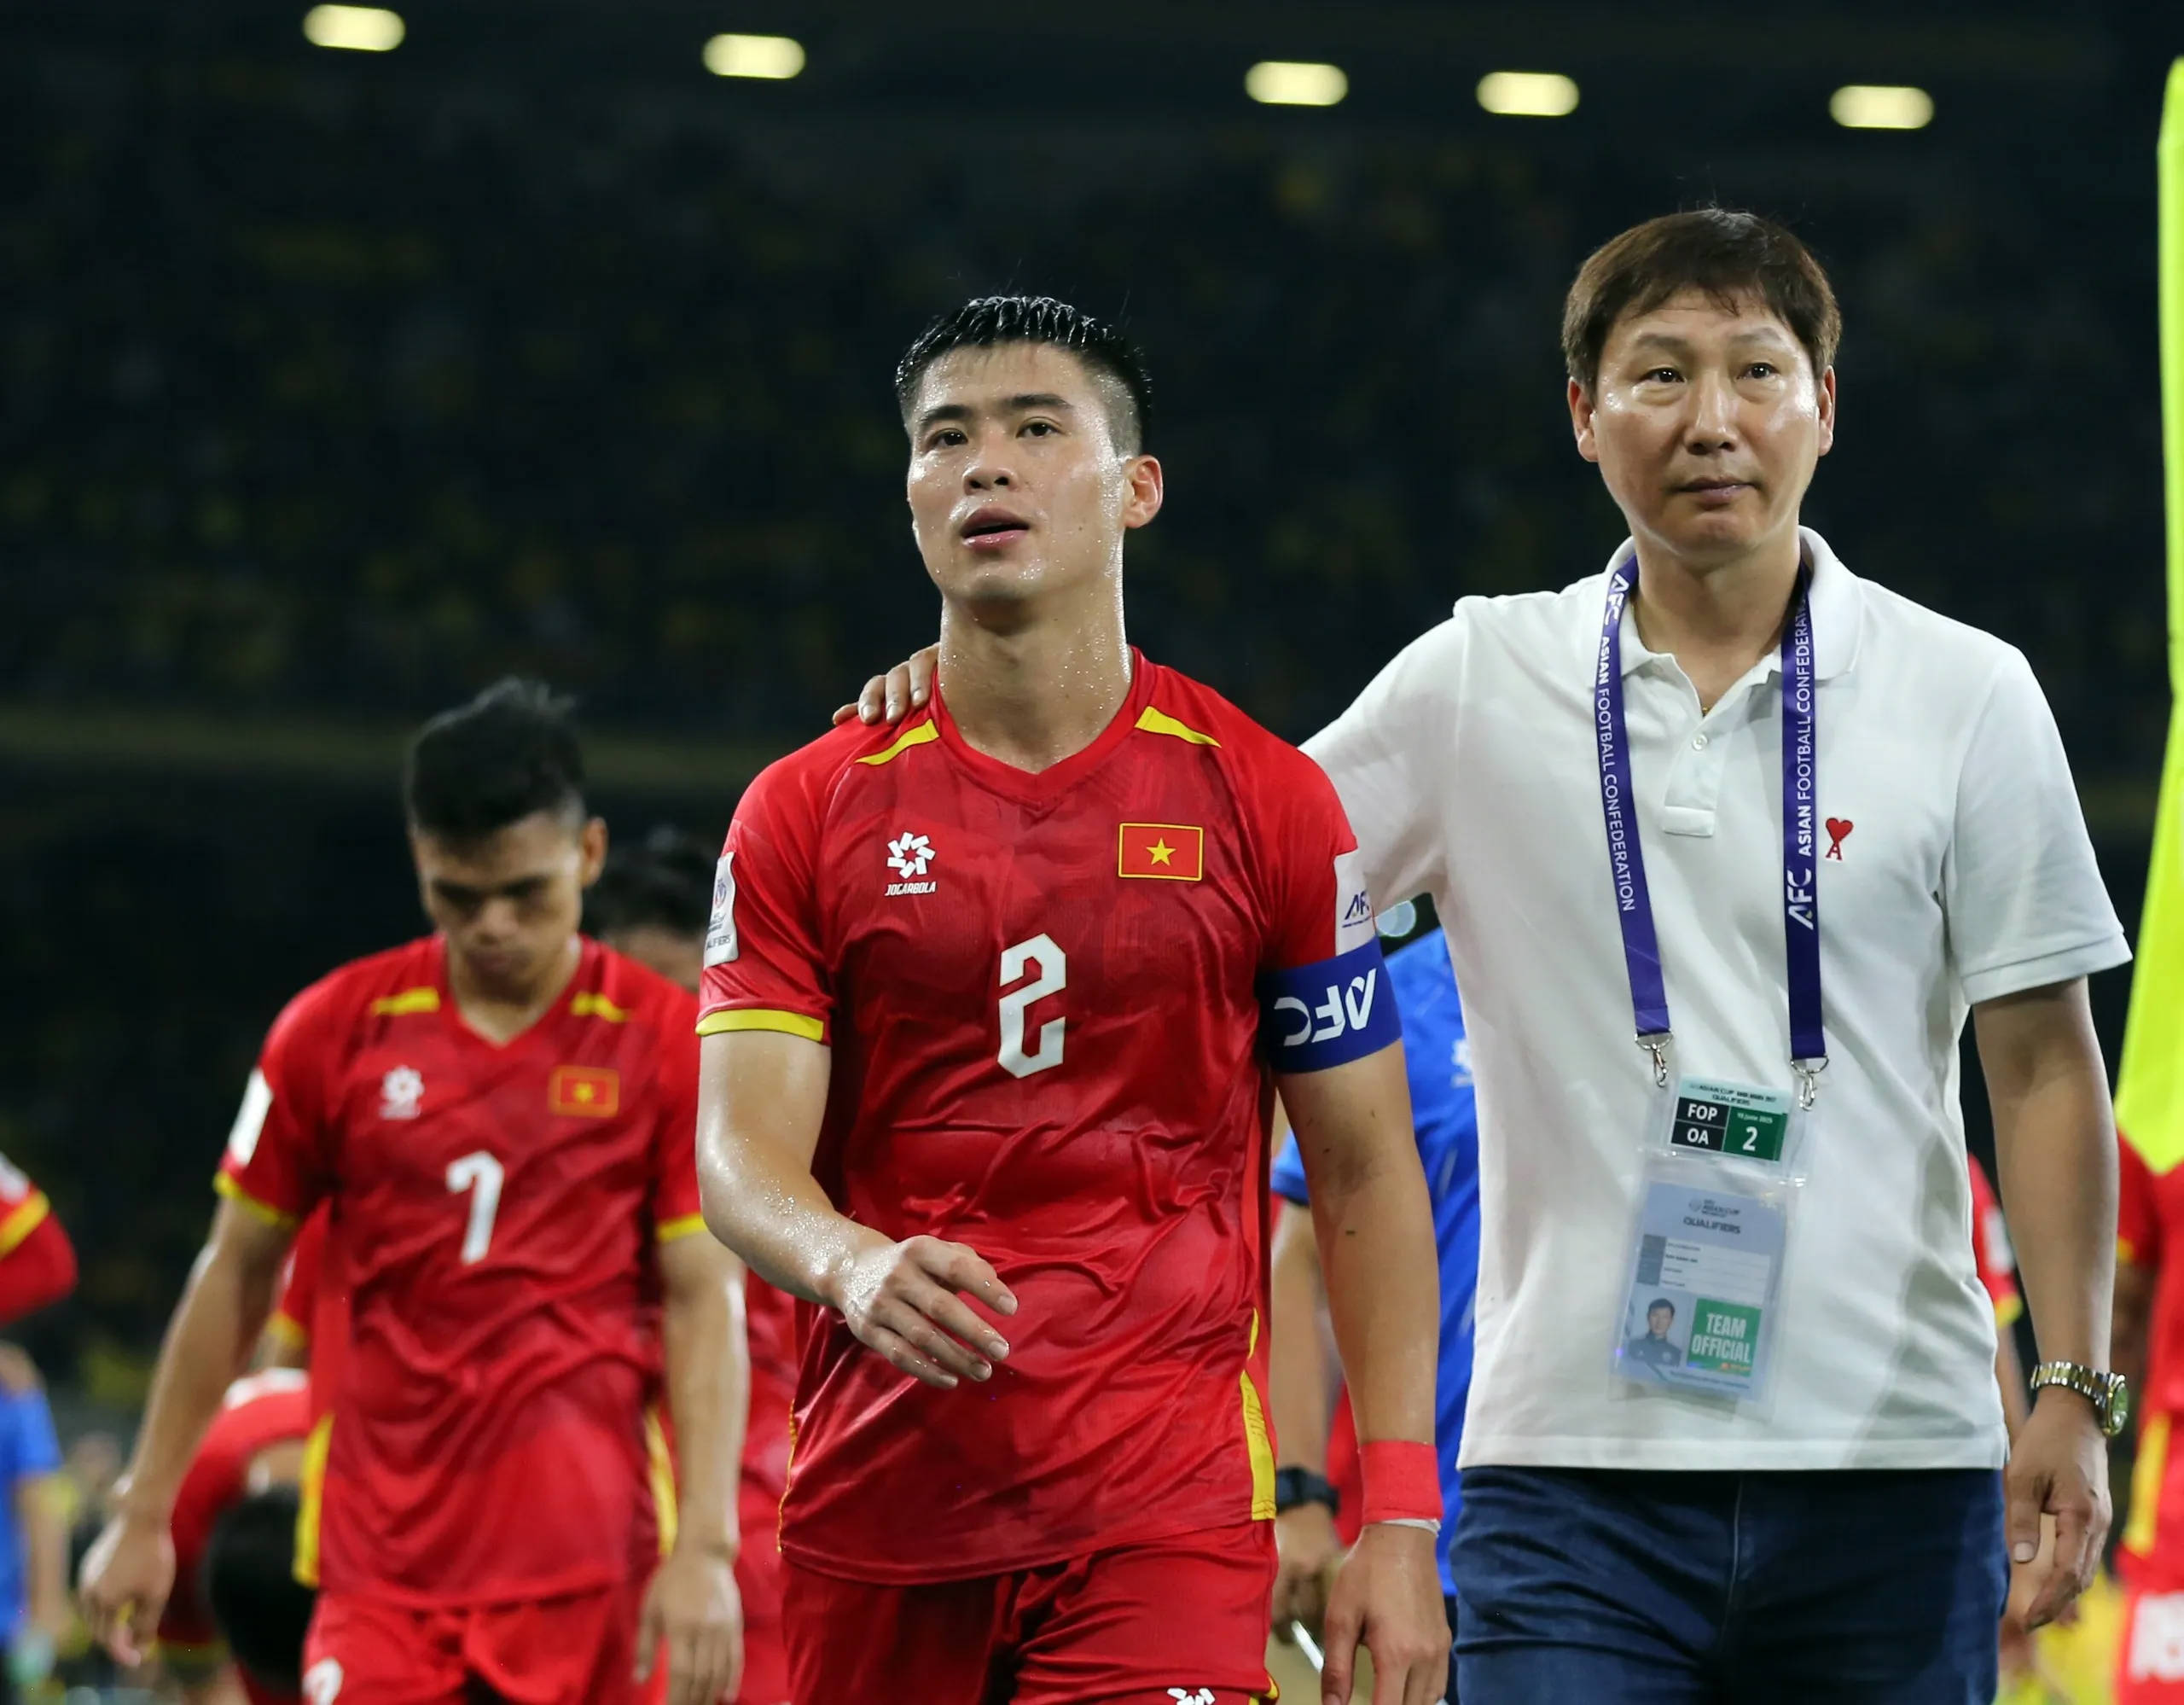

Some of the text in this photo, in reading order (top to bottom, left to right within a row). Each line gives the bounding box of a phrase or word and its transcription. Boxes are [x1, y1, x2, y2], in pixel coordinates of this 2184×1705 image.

[1597, 573, 1635, 911] AFC ASIAN FOOTBALL CONFEDERATION
[1786, 599, 1815, 930] AFC ASIAN FOOTBALL CONFEDERAT
[884, 881, 937, 897] JOGARBOLA
[1344, 889, 1370, 921] AF
[997, 933, 1066, 1079] 2
[1273, 968, 1377, 1046] AFC
[1687, 1103, 1718, 1122] FOP
[1686, 1127, 1710, 1146] OA
[1742, 1126, 1759, 1152] 2
[445, 1149, 505, 1266] 7
[1682, 1216, 1741, 1235] QUALIFIERS
[1706, 1312, 1747, 1340] TEAM
[1691, 1334, 1751, 1364] OFFICIAL
